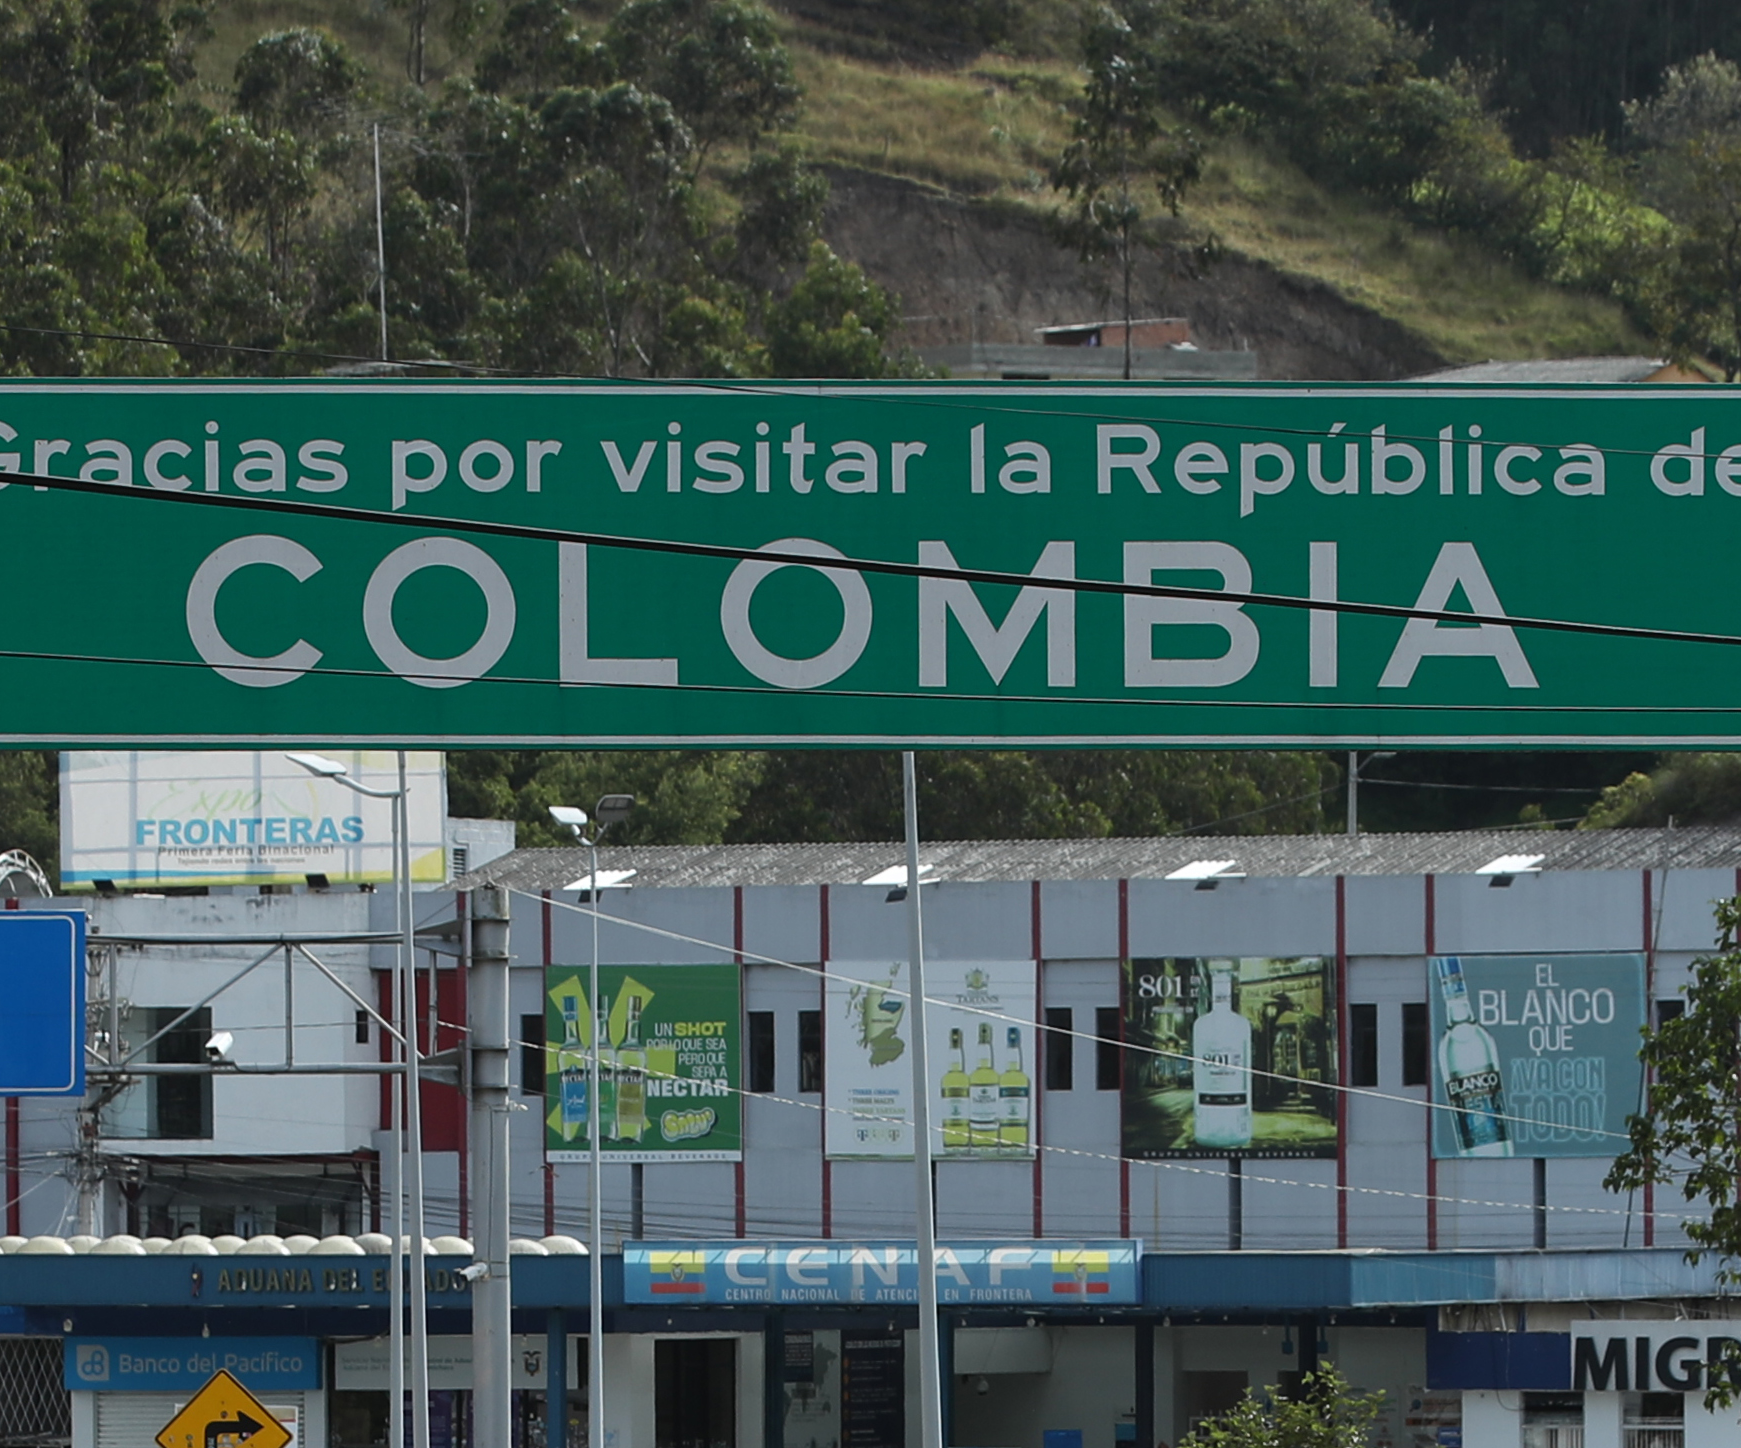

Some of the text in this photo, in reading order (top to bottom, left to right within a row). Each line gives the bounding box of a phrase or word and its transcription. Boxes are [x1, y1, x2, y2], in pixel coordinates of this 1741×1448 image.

[392, 438, 562, 510] por
[600, 421, 927, 494] visitar
[971, 424, 1052, 496] la
[1096, 422, 1606, 519] República
[186, 534, 1540, 690] COLOMBIA
[136, 816, 364, 845] FRONTERAS
[160, 843, 334, 858] Primera Feria Binacional
[1138, 975, 1183, 998] 801
[1535, 964, 1559, 987] EL
[1478, 988, 1615, 1026] BLANCO
[654, 1022, 726, 1037] UN SHOT
[1529, 1025, 1574, 1056] QUE
[682, 1038, 702, 1051] QUE
[706, 1037, 726, 1050] SEA
[678, 1052, 725, 1066] PERO QUE
[719, 1066, 727, 1077] A
[1559, 1056, 1606, 1092] CON
[647, 1079, 728, 1097] NECTAR
[1448, 1073, 1498, 1095] BLANCO
[724, 1246, 1033, 1286] CENAF
[218, 1269, 364, 1292] ADUANA DEL
[725, 1288, 771, 1301] CENTRO
[782, 1288, 840, 1301] NACIONAL
[875, 1288, 920, 1301] ATENCI
[944, 1288, 959, 1301] EN
[970, 1288, 1033, 1301] FRONTERA
[119, 1352, 303, 1374] Banco del Pacífico
